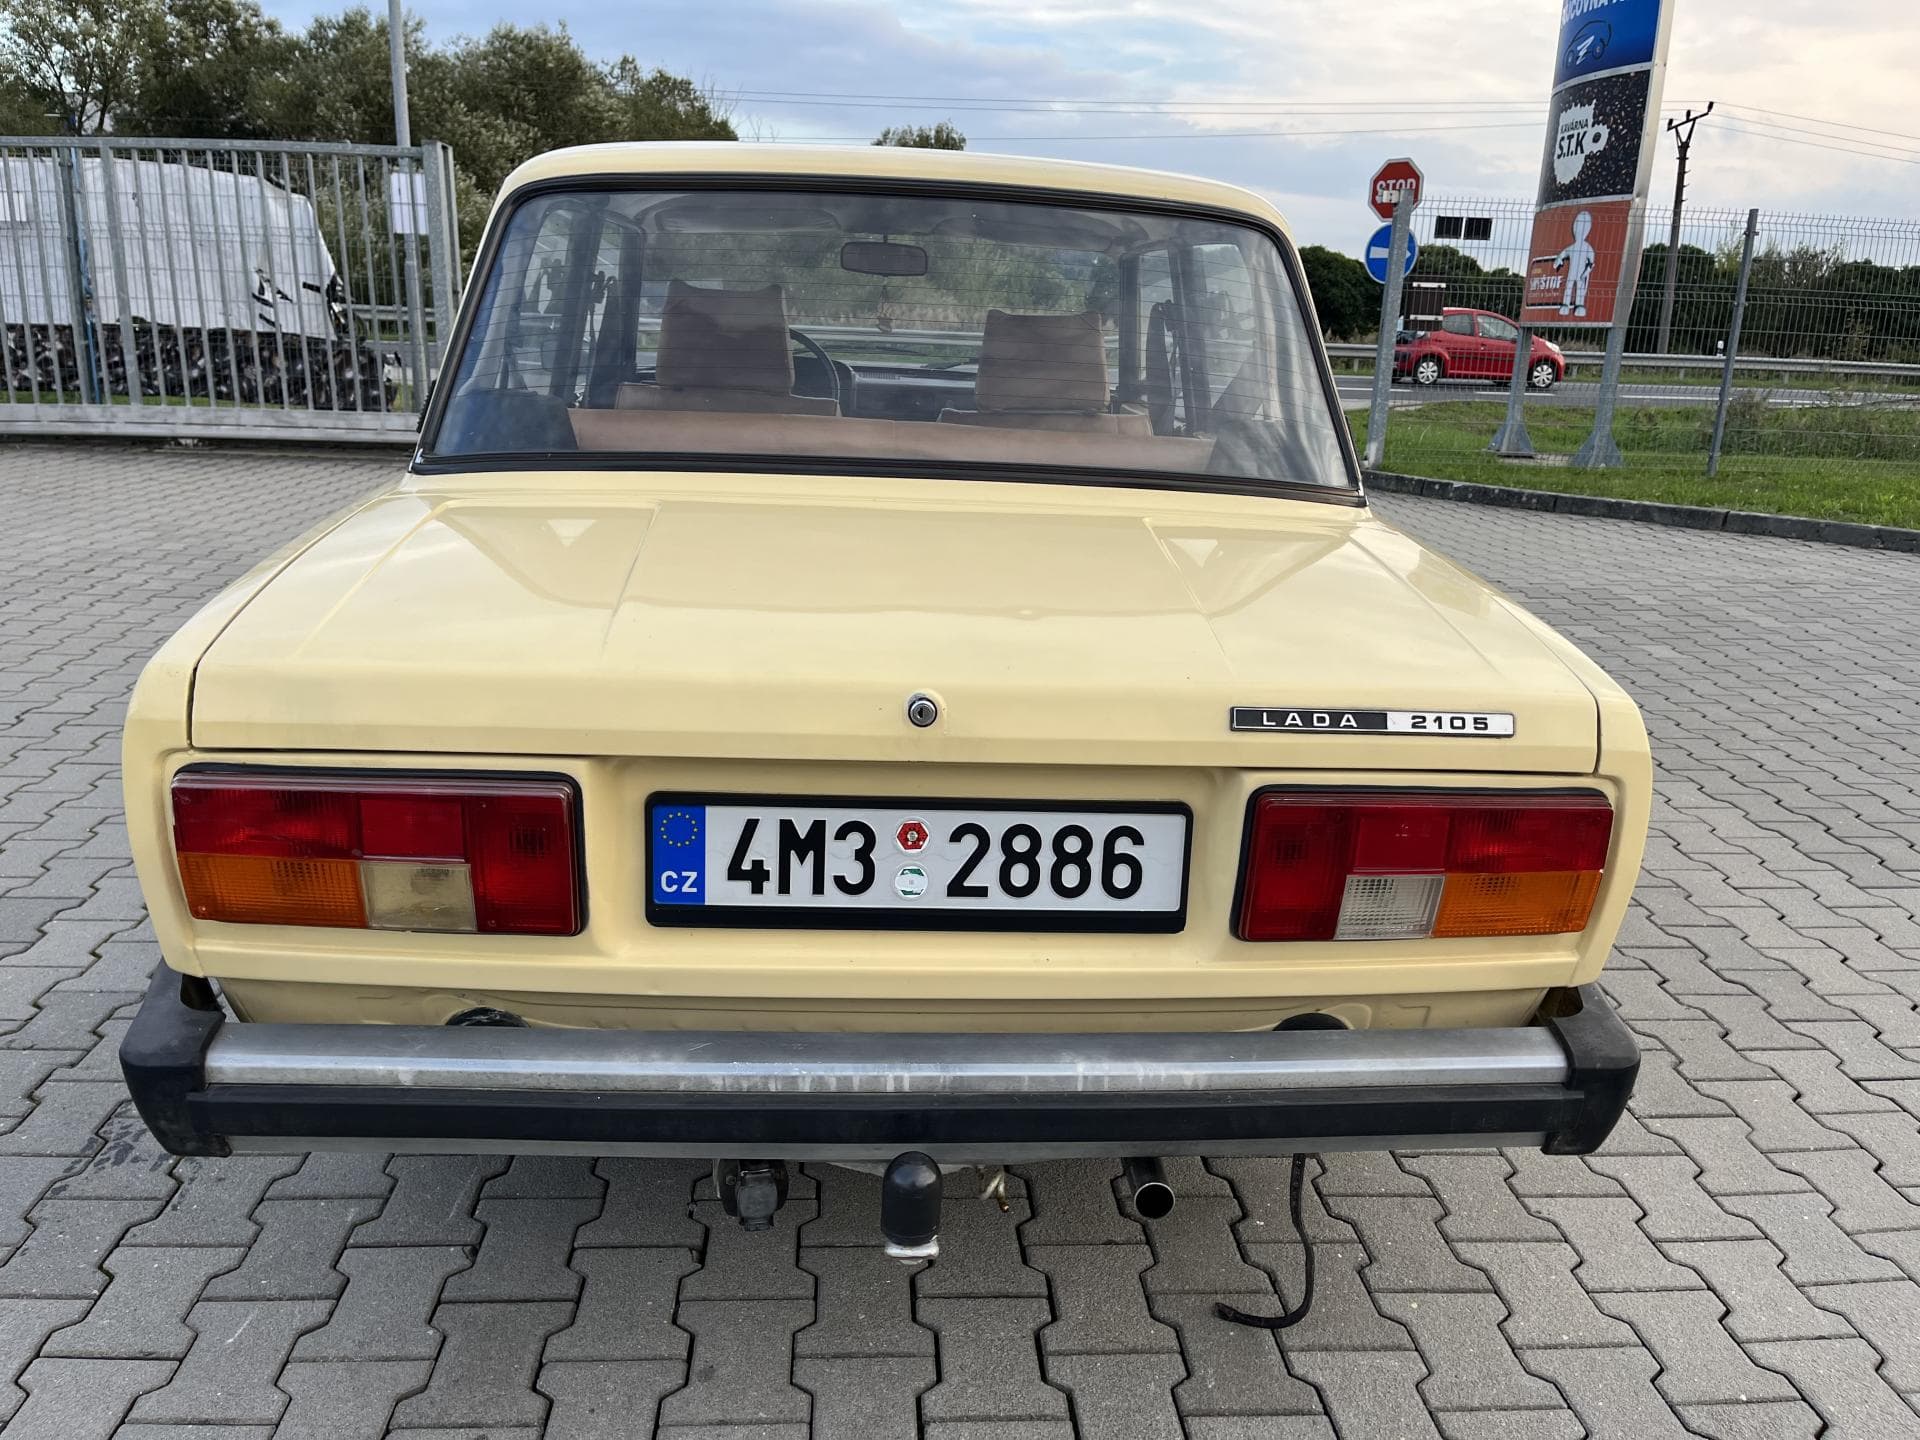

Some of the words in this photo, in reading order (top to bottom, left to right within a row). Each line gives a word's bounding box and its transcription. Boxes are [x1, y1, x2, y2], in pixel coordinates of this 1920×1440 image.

[1262, 711, 1358, 728] LADA
[1411, 715, 1489, 731] 2105
[727, 818, 877, 896] 4M3
[946, 822, 1145, 900] 2886
[660, 871, 698, 893] CZ
